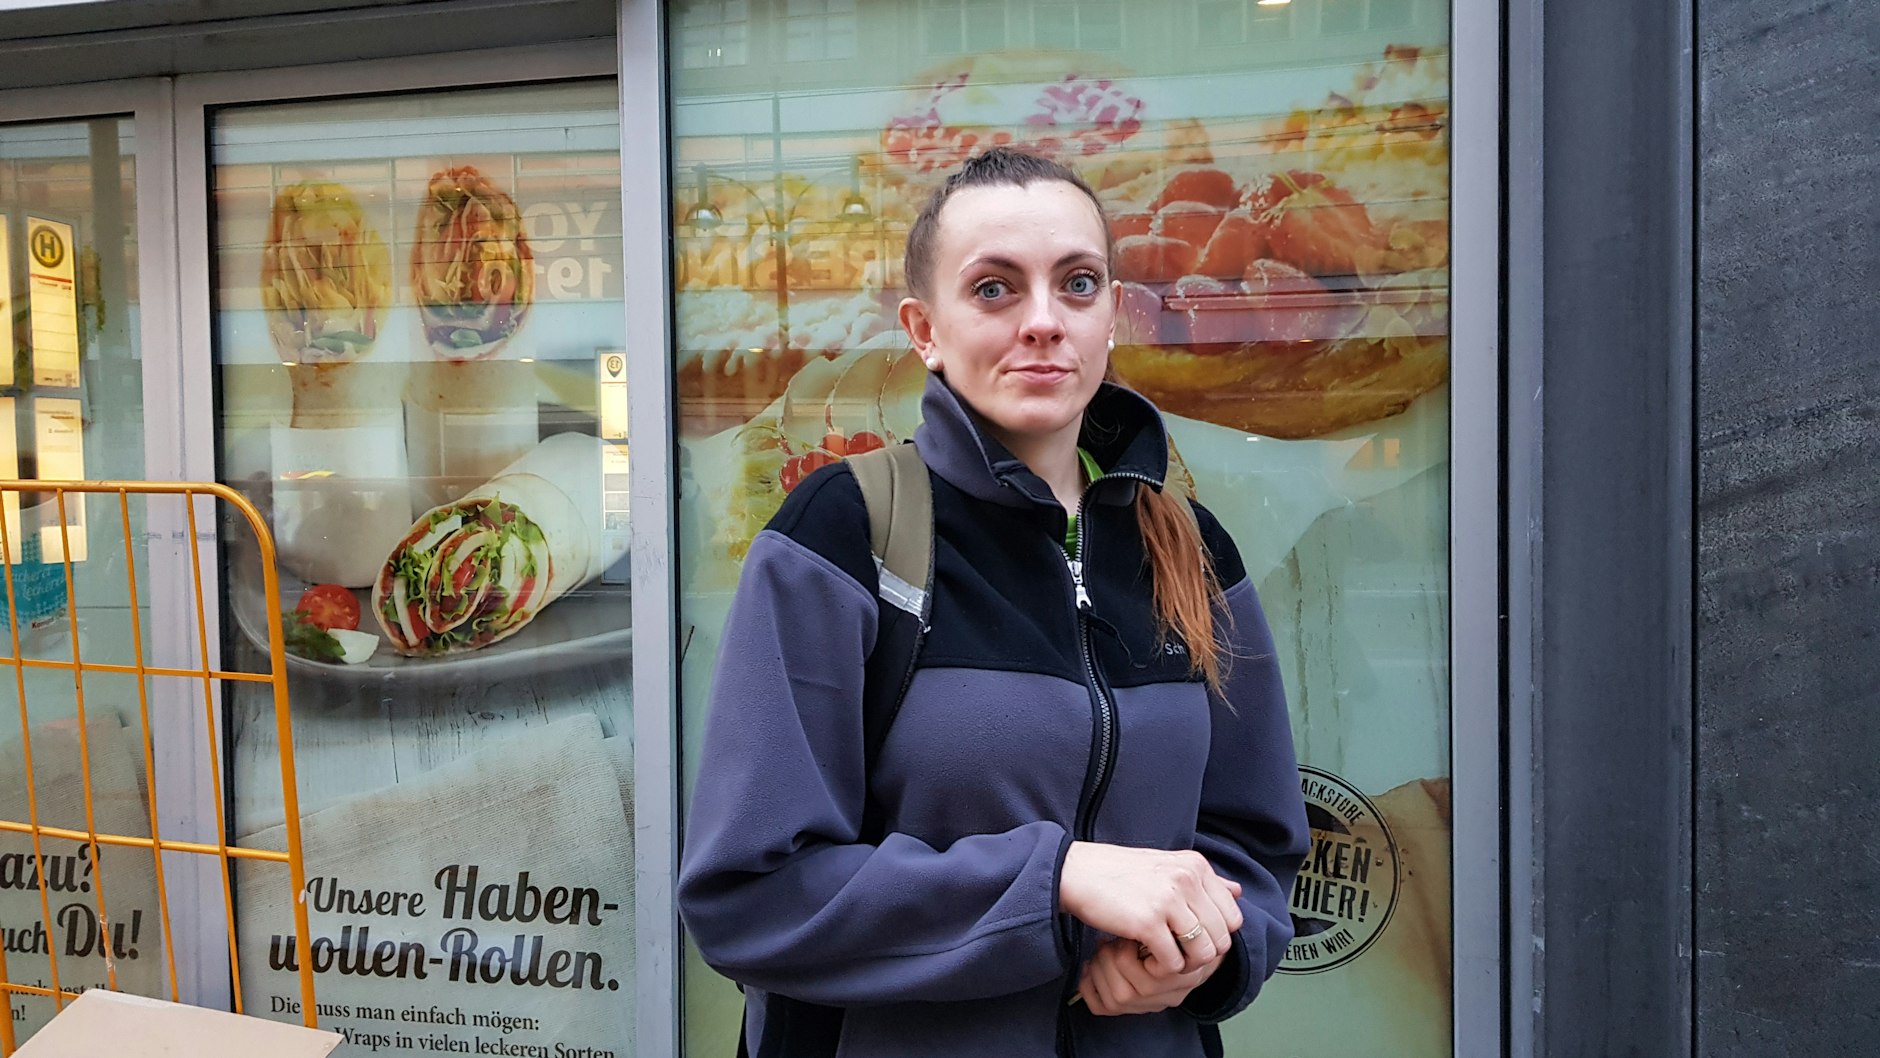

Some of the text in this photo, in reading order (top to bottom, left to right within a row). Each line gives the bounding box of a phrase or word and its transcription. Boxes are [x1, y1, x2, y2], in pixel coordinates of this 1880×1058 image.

[307, 864, 619, 926] Unsere Haben-
[1293, 874, 1370, 923] HIER!
[57, 903, 142, 960] Du!
[1321, 928, 1355, 955] WIR!
[268, 924, 619, 991] wollen-Rollen.
[270, 996, 300, 1014] Die
[356, 1005, 395, 1021] man
[401, 1006, 466, 1026] einfach
[472, 1010, 539, 1034] mögen:
[396, 1031, 413, 1049] in
[418, 1033, 469, 1054] vielen
[475, 1036, 548, 1058] leckeren
